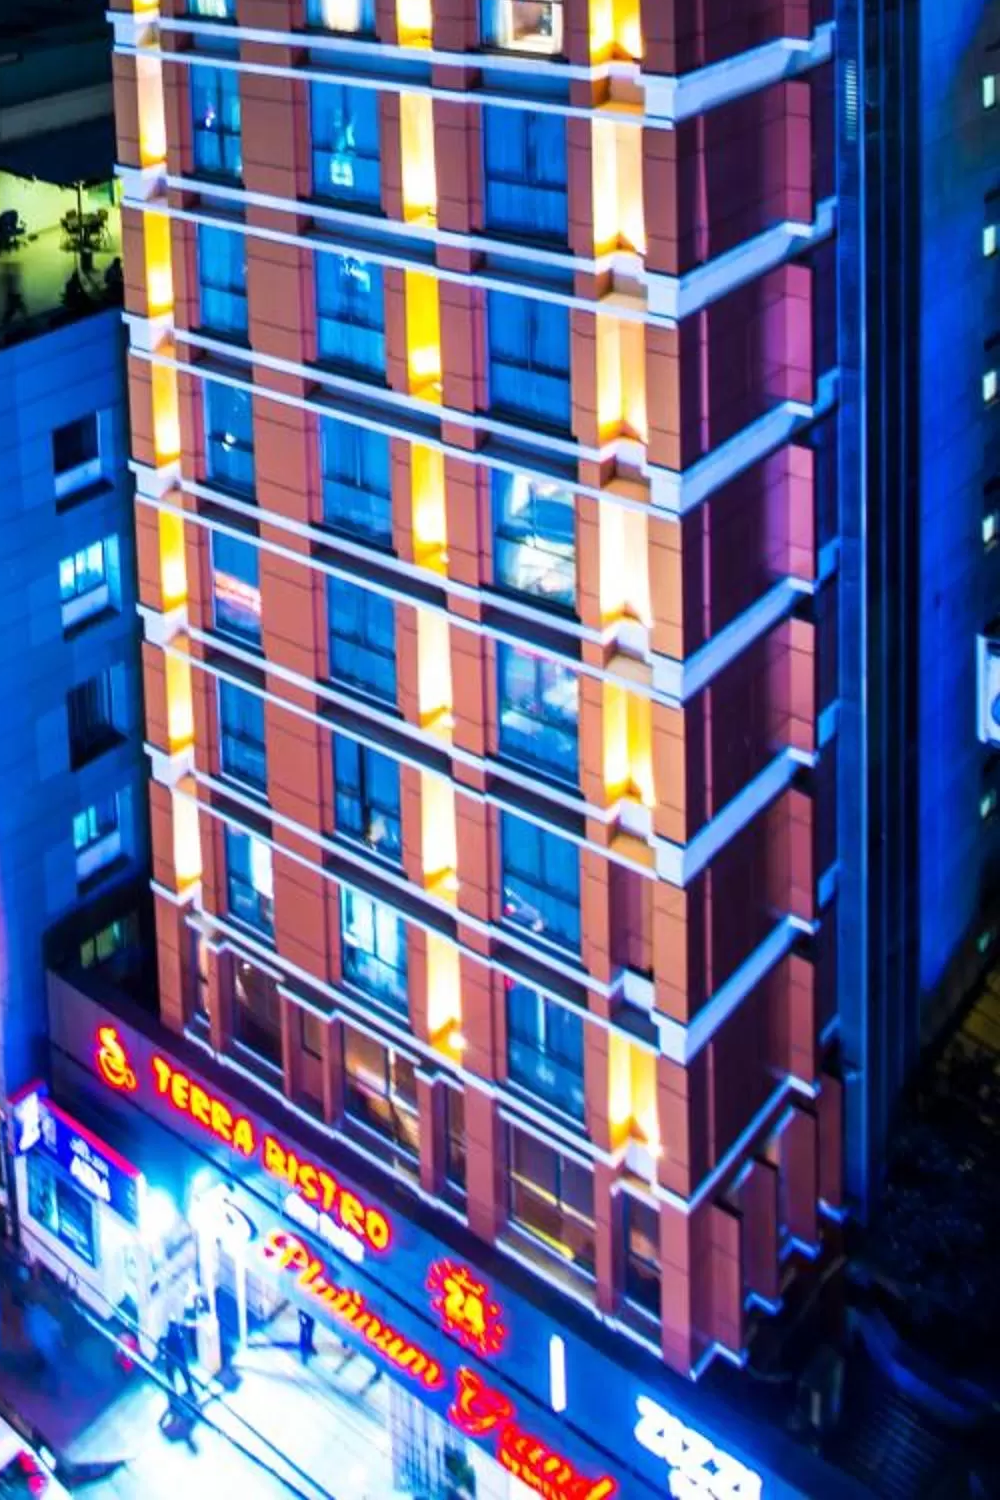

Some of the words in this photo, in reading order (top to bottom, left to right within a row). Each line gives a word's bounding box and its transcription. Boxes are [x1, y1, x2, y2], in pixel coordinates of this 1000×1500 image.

[151, 1054, 257, 1159] TERRA
[263, 1133, 392, 1252] BISTRO
[262, 1230, 444, 1388] Platinum
